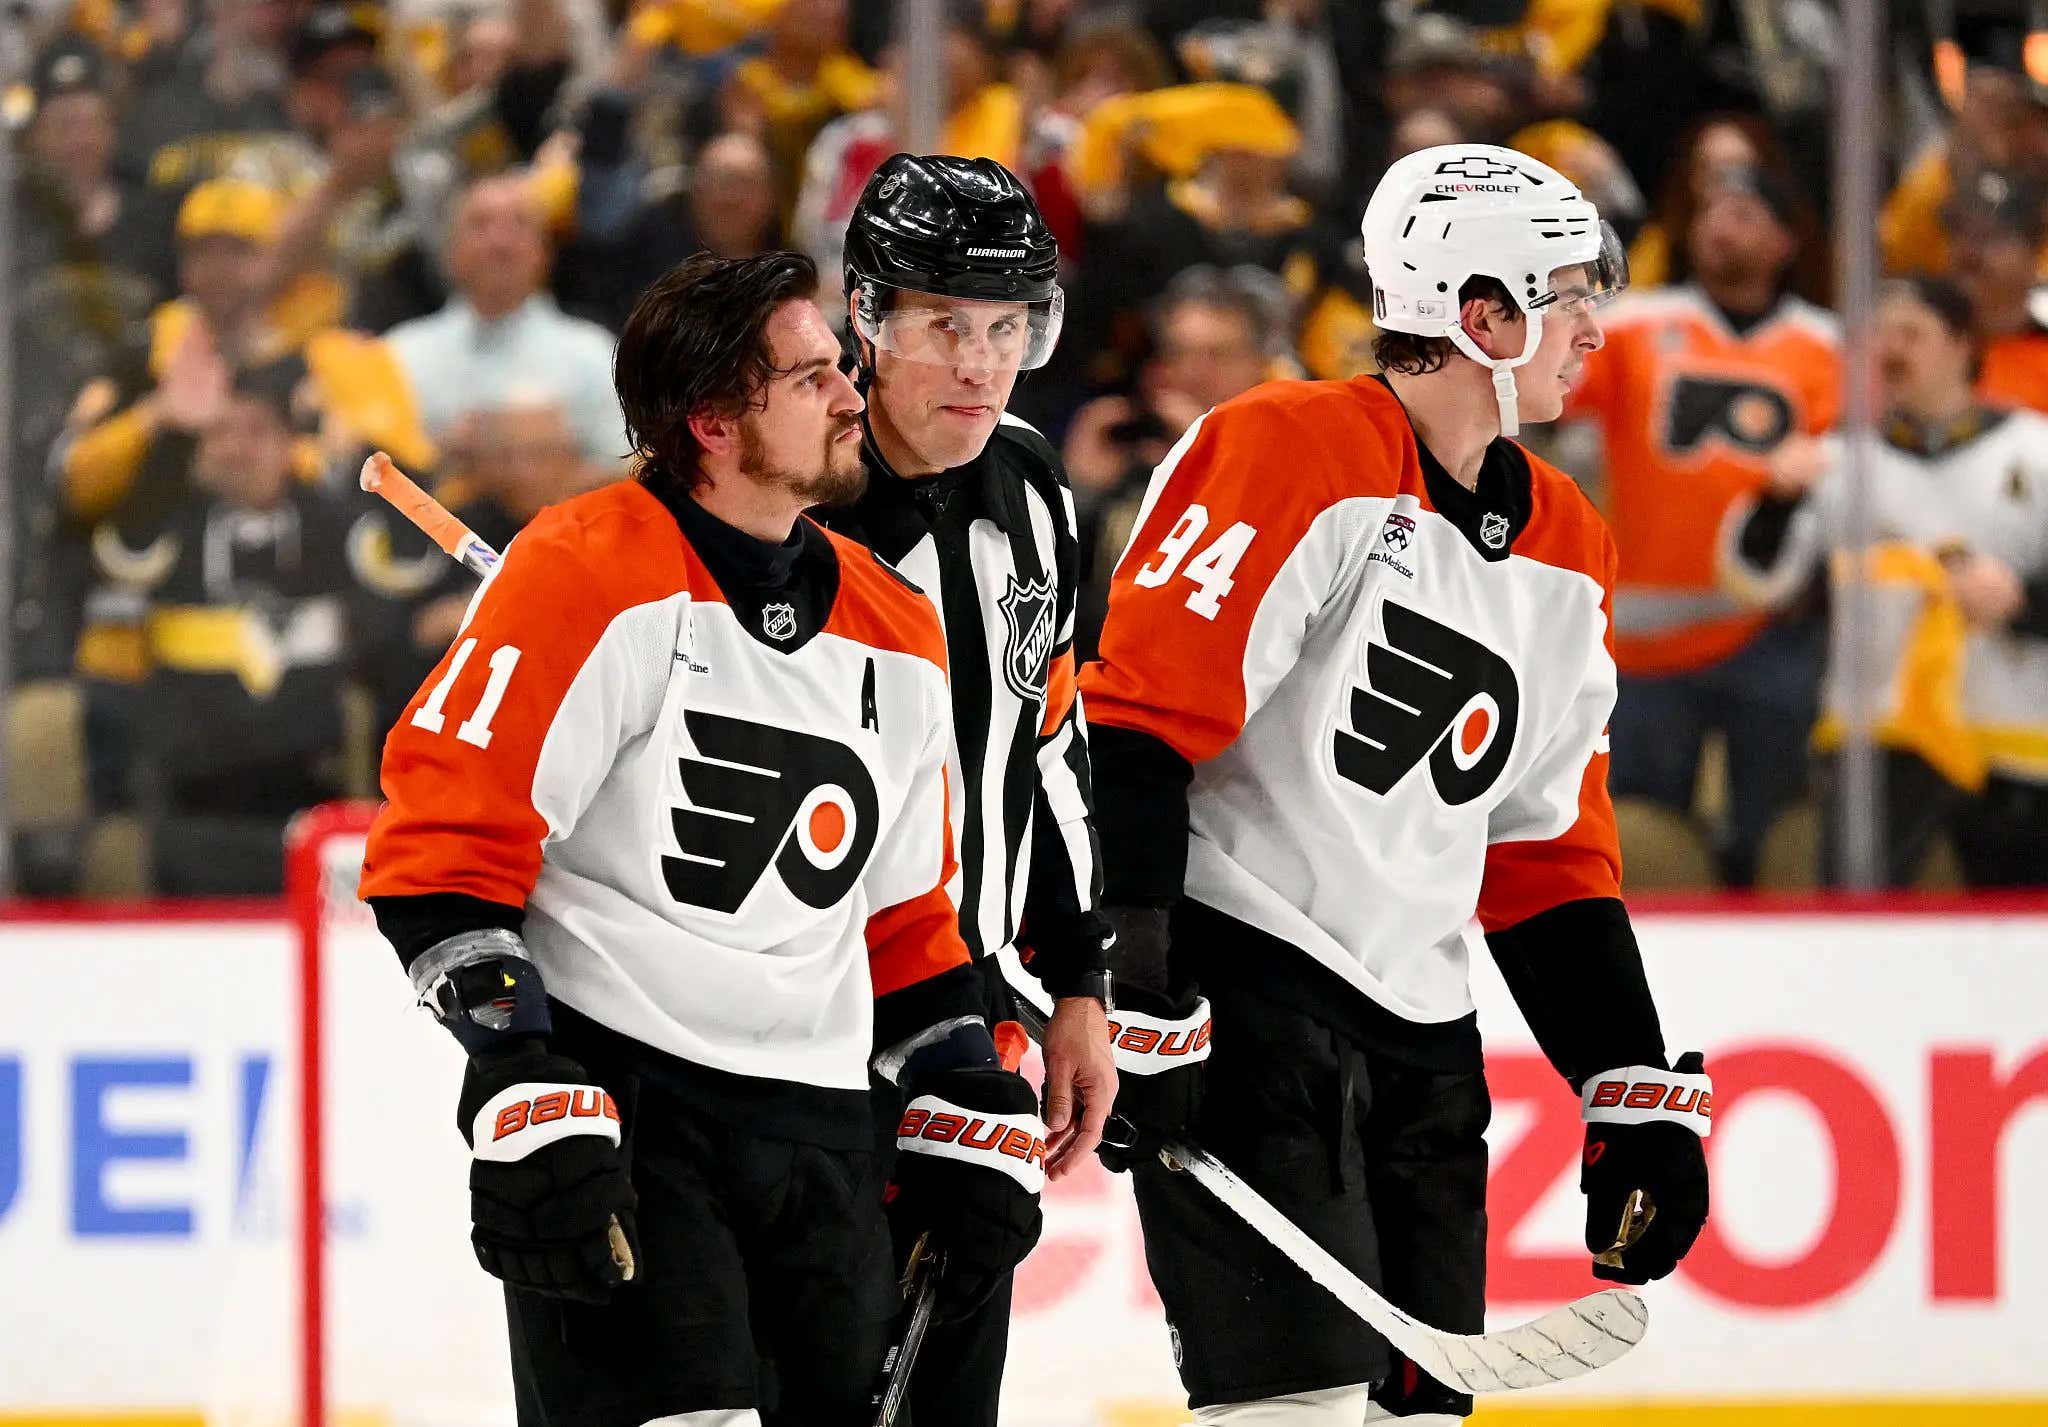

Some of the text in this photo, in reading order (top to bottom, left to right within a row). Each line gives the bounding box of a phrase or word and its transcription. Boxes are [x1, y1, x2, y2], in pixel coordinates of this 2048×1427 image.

[1434, 184, 1520, 194] CHEVROLET
[966, 247, 1026, 259] WARRIOR
[1133, 503, 1258, 621] 94
[689, 662, 709, 674] cine
[410, 637, 522, 750] 11
[861, 656, 879, 734] A
